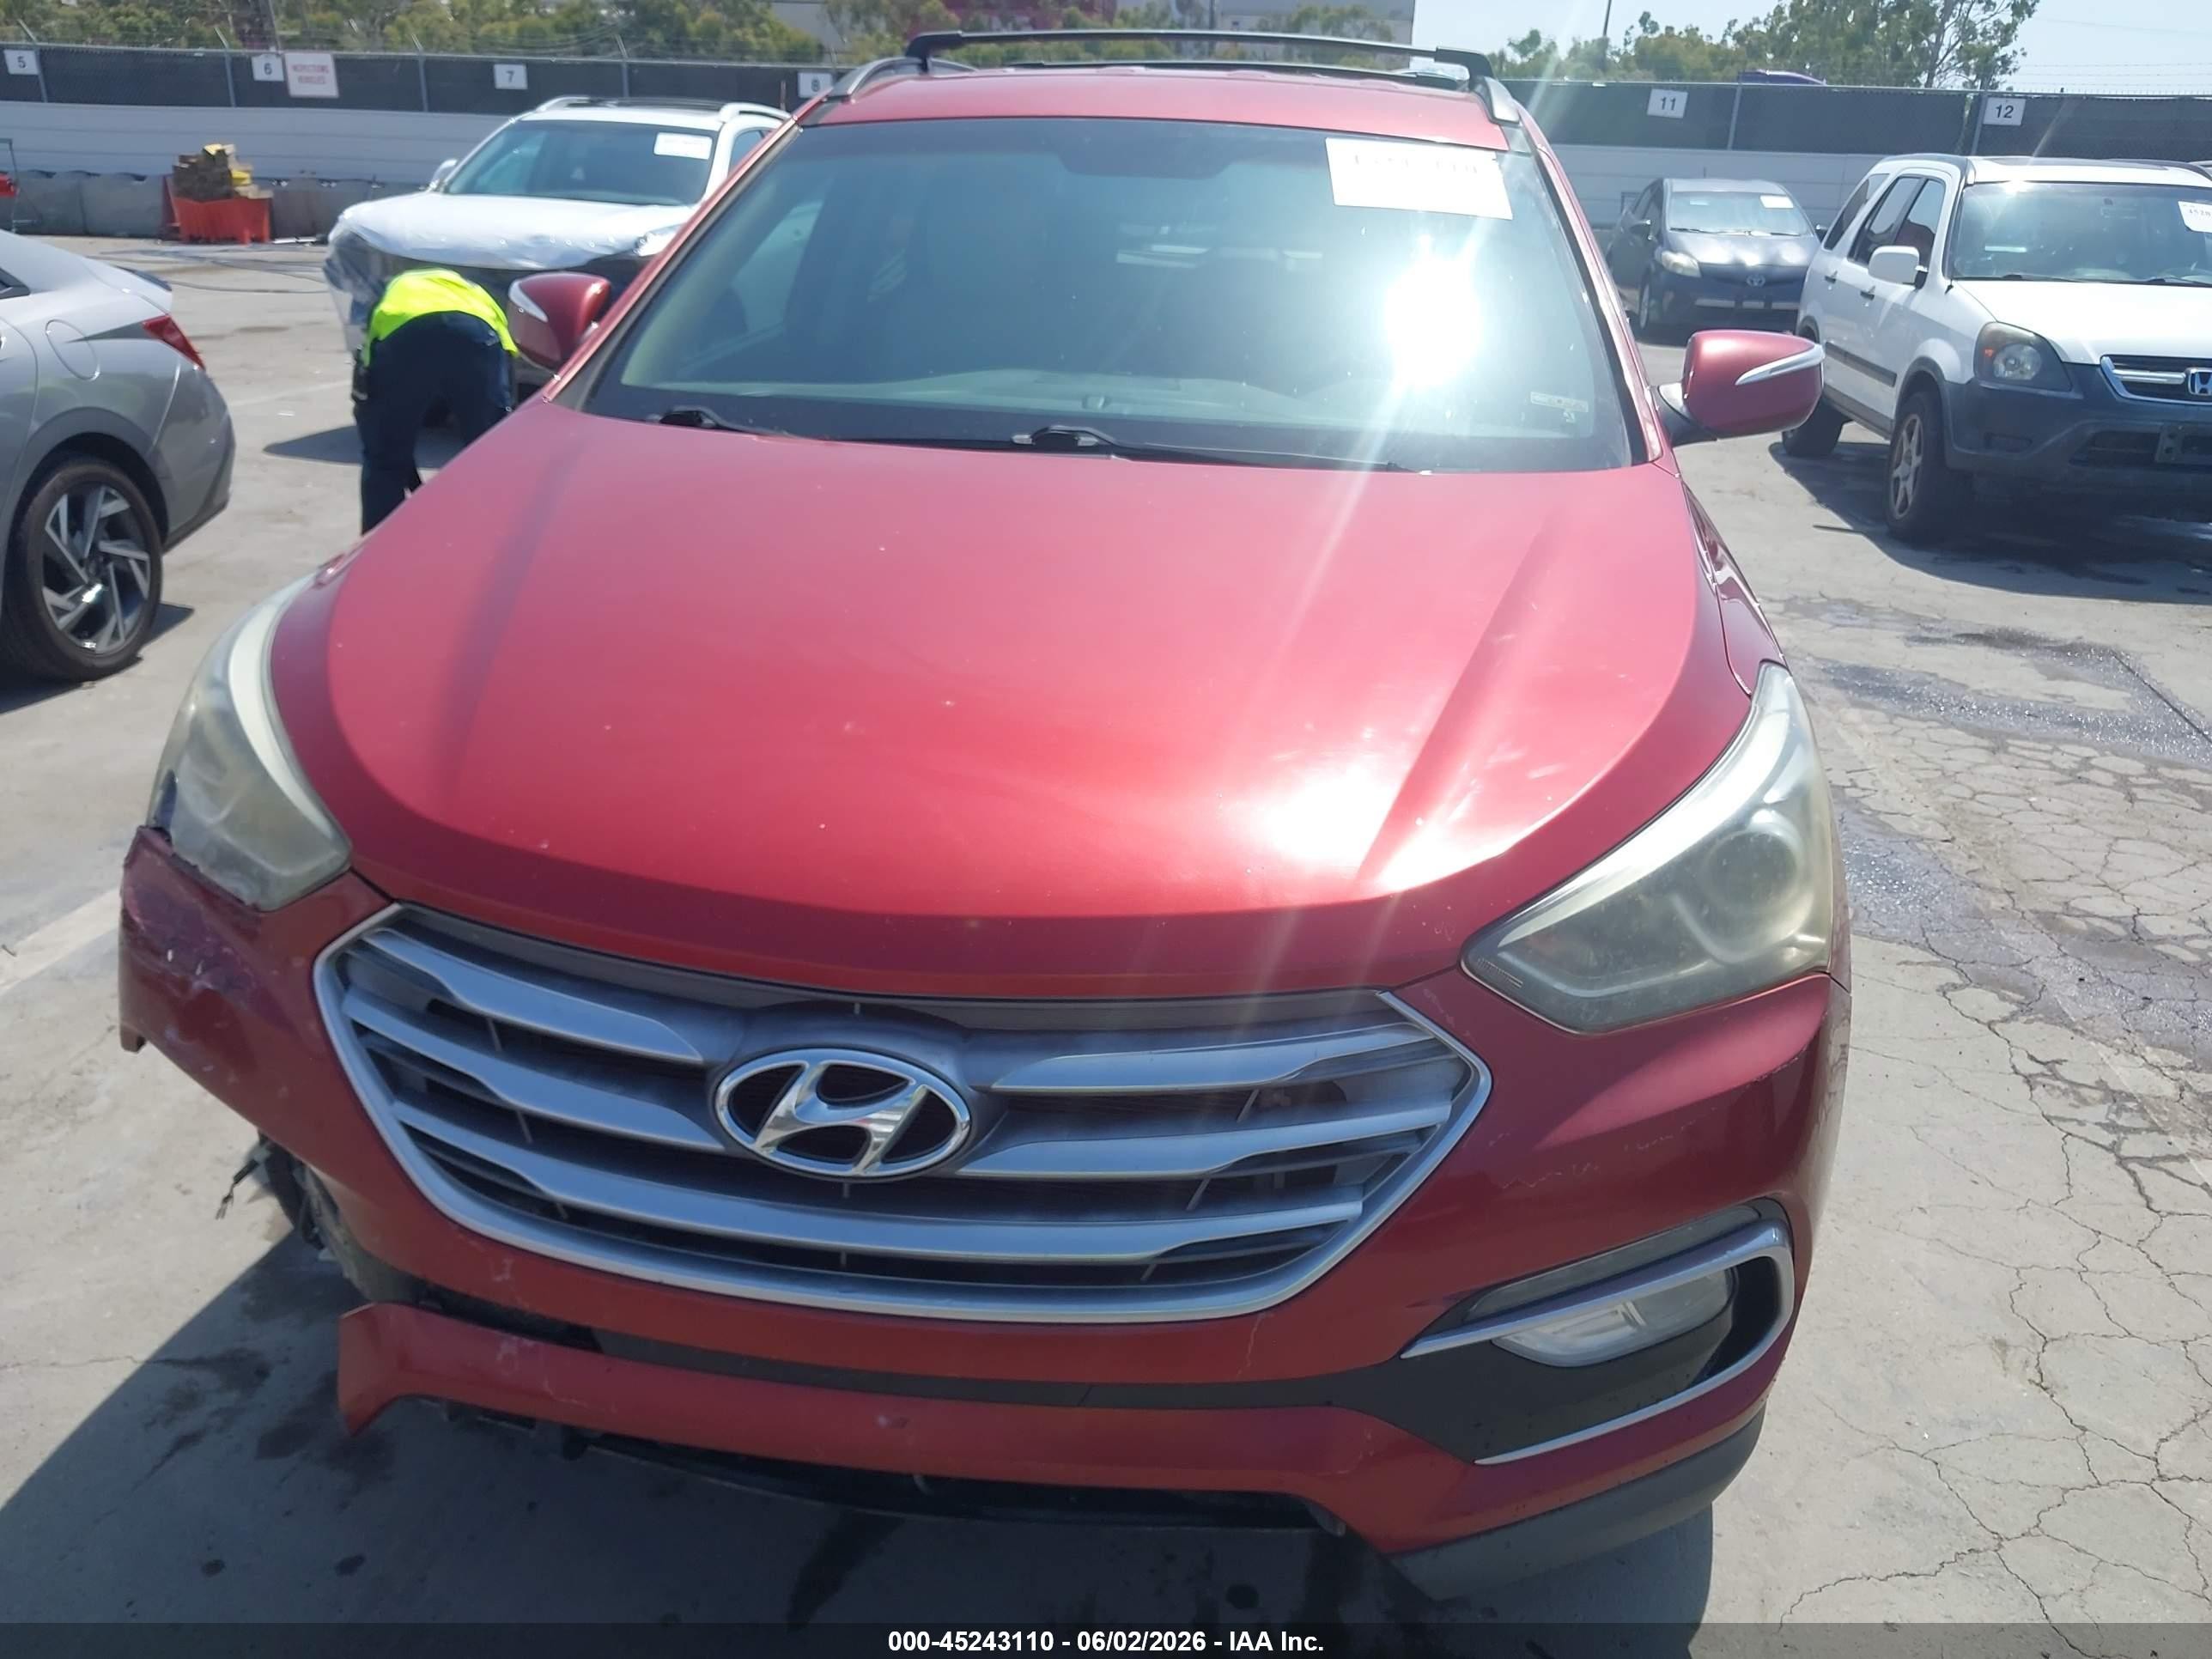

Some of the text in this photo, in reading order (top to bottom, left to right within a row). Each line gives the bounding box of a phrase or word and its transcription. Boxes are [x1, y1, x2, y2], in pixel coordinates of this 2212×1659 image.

[17, 56, 27, 69] 5
[264, 64, 272, 76] 6
[506, 70, 515, 83] 7
[1660, 97, 1676, 111] 11
[1996, 104, 2014, 118] 12
